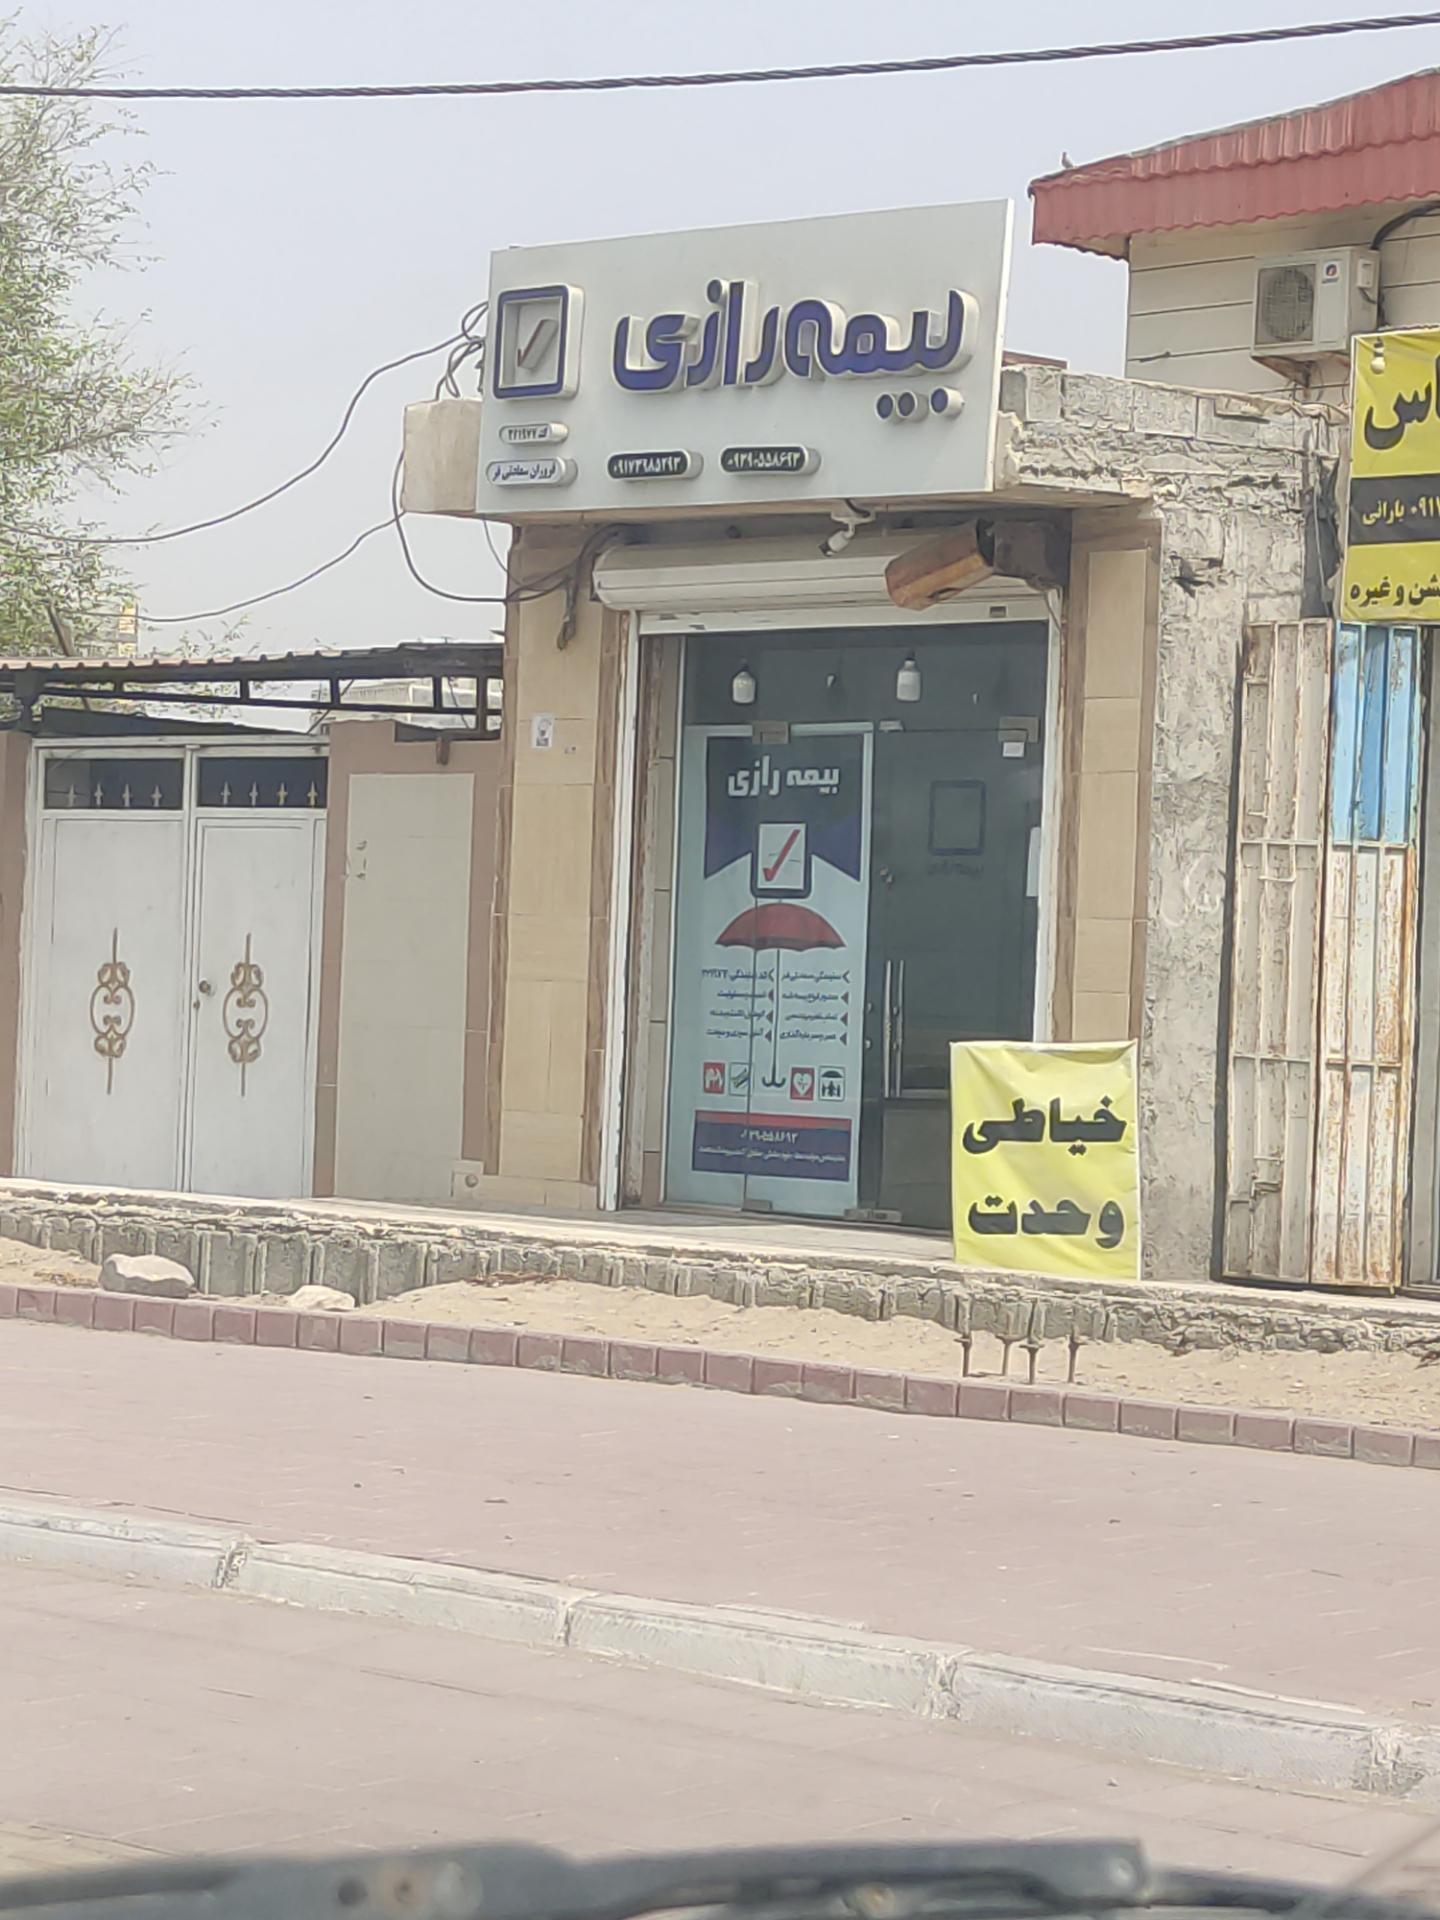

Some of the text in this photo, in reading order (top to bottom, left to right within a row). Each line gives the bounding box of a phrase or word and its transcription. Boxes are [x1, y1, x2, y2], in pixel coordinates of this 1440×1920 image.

[612, 278, 972, 421] بیمه رازی
[1350, 575, 1391, 608] غیره
[1393, 585, 1404, 607] و
[727, 754, 840, 797] بیمه رازی
[962, 1095, 1127, 1156] خیاطی
[968, 1195, 1125, 1250] وحدت
